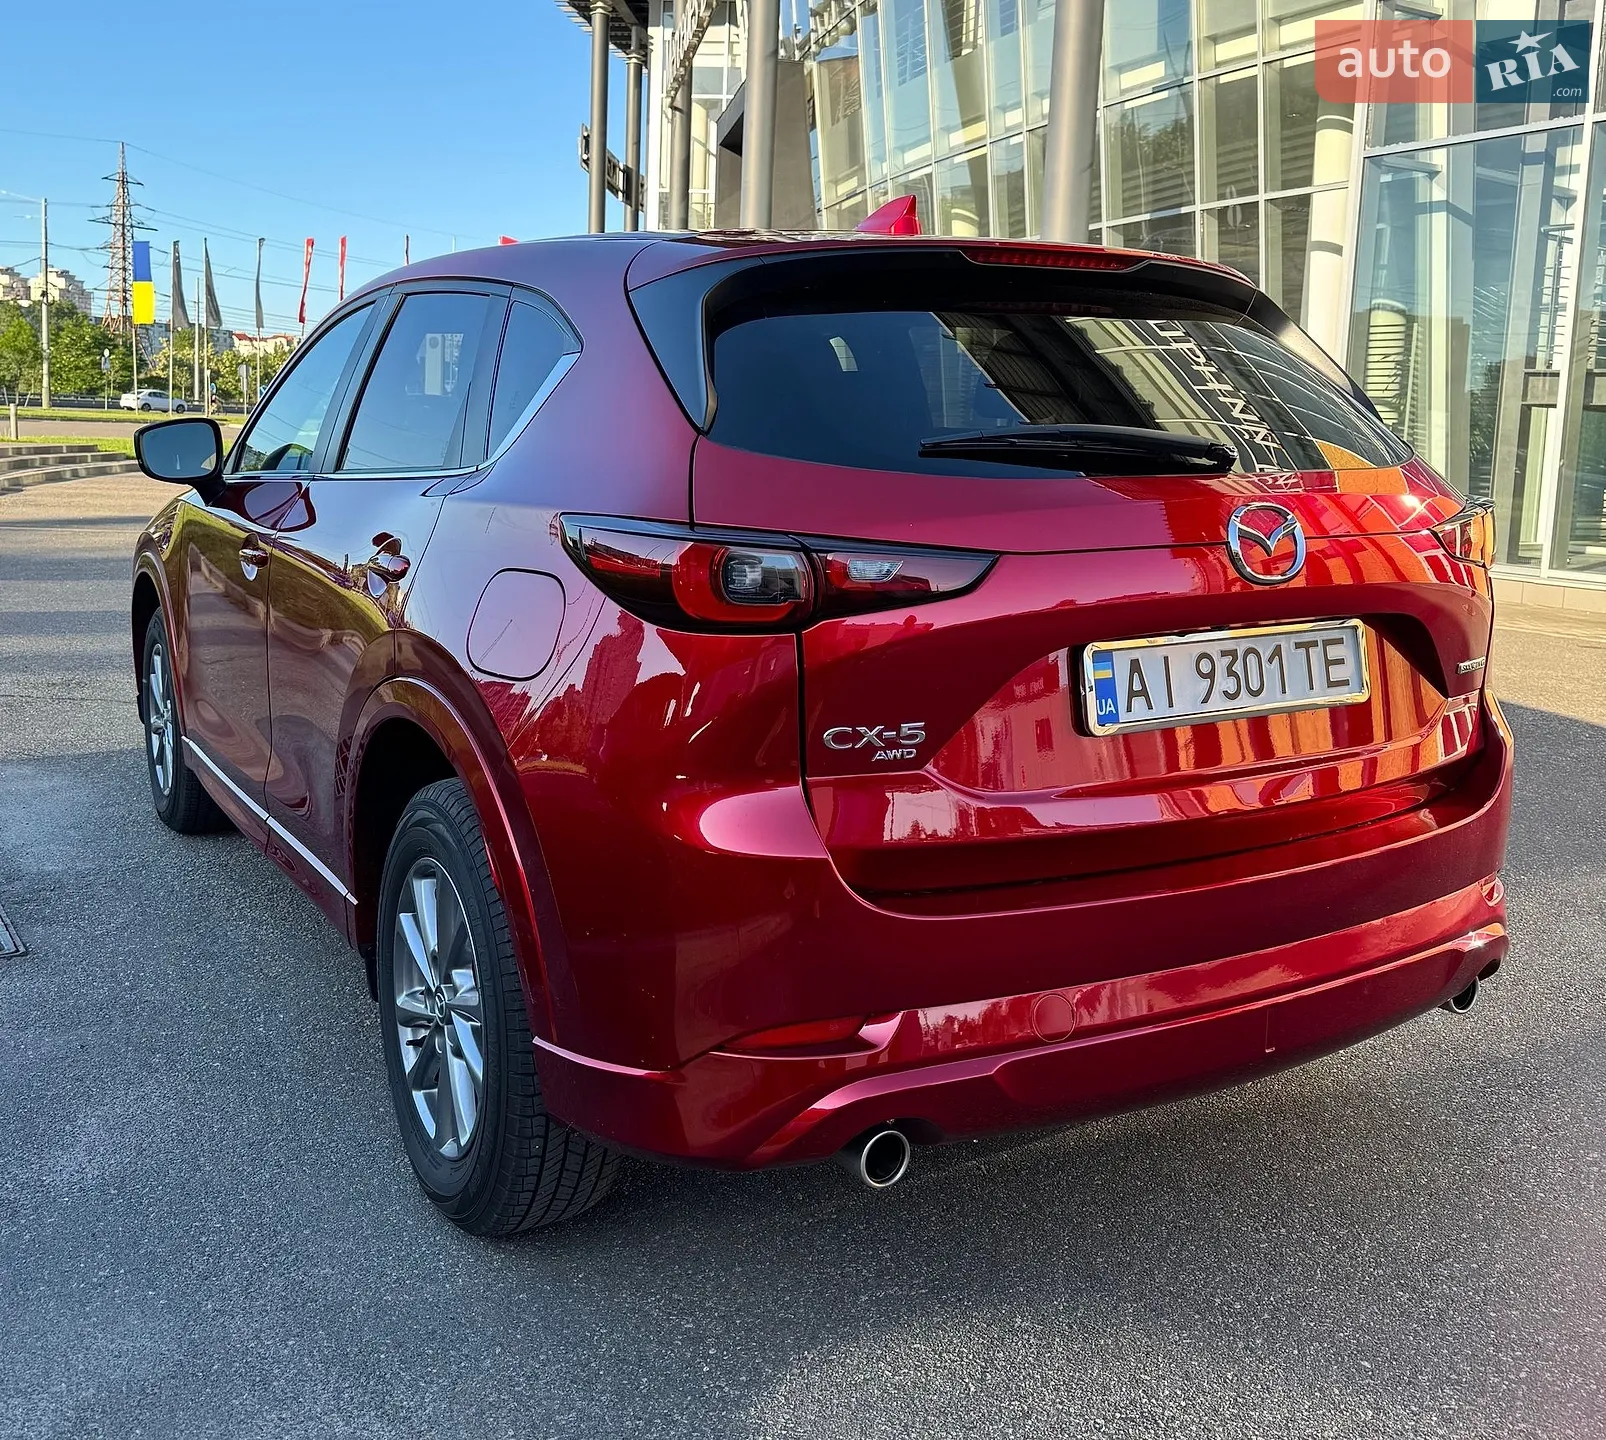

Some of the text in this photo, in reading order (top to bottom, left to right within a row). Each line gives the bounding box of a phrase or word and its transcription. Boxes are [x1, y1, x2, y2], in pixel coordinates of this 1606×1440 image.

[1126, 637, 1350, 713] AI 9301 TE
[1097, 699, 1116, 716] UA
[823, 721, 926, 750] CX-5
[871, 748, 918, 762] AWD
